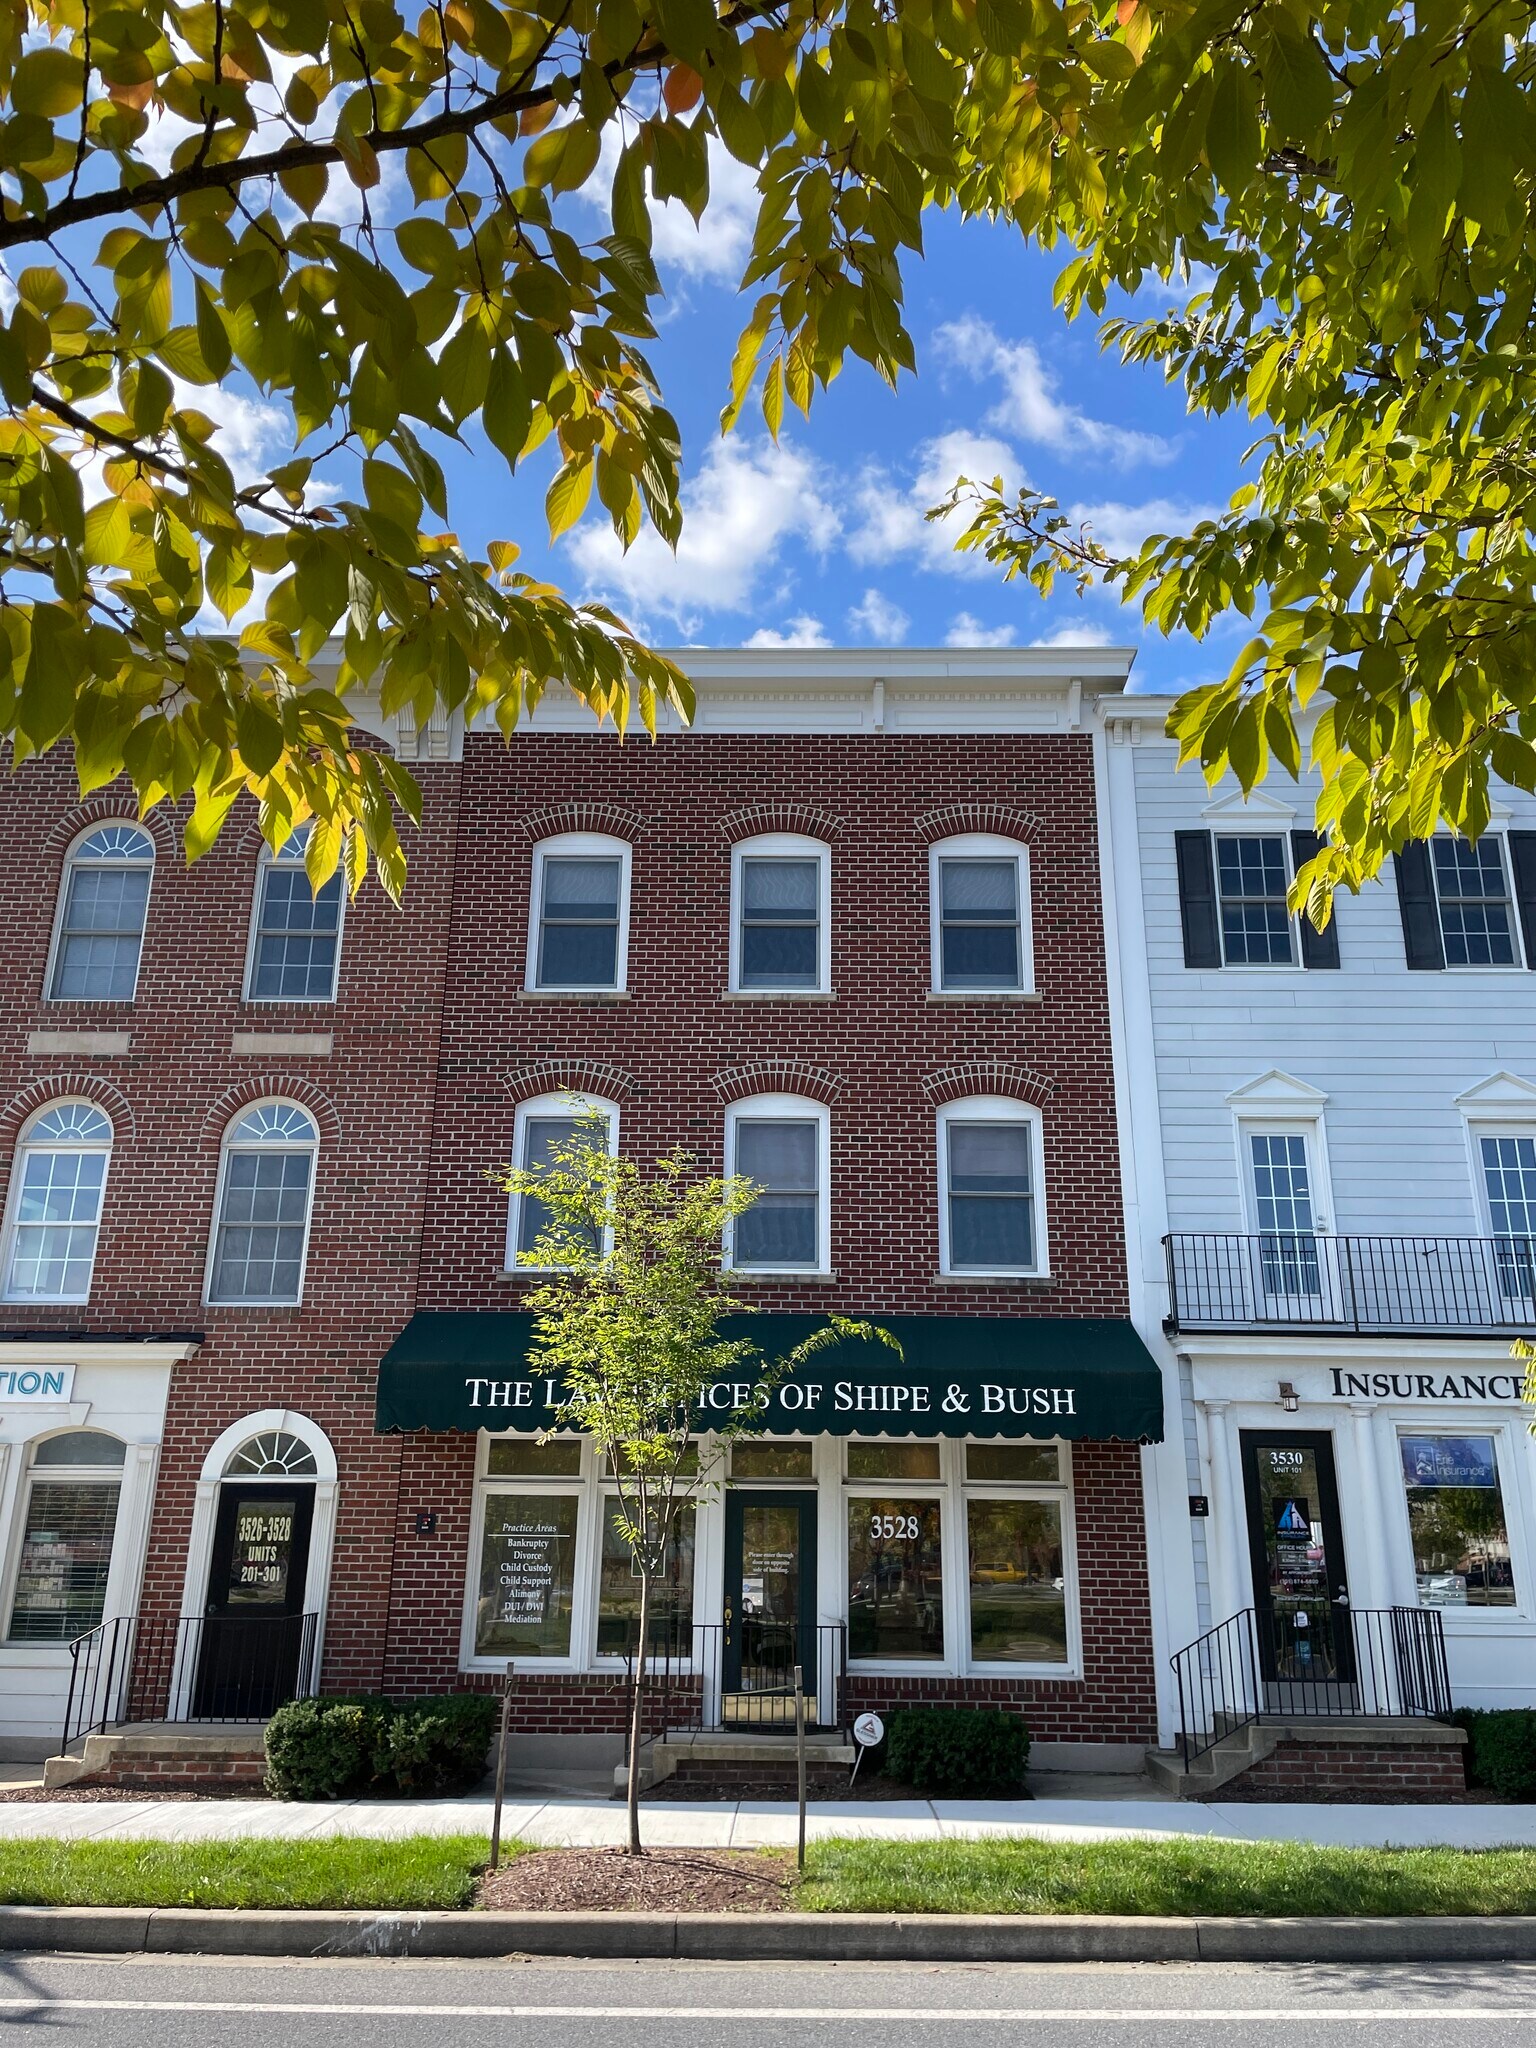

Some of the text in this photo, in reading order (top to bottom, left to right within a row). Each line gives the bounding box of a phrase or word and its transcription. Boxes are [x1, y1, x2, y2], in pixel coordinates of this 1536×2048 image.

[1329, 1368, 1527, 1399] INSURANCE
[465, 1378, 533, 1408] THE
[632, 1379, 770, 1410] ICES
[779, 1383, 823, 1411] OF
[834, 1381, 932, 1412] SHIPE
[941, 1383, 971, 1413] &
[980, 1384, 1077, 1414] BUSH
[1270, 1451, 1303, 1465] 3530
[1435, 1453, 1455, 1465] Erie
[1437, 1464, 1485, 1476] Insurance
[239, 1517, 292, 1541] 3526-3528
[502, 1523, 557, 1532] Practice Areas
[871, 1515, 919, 1539] 3528
[507, 1538, 549, 1549] Bankruptcy
[248, 1546, 277, 1561] UNITS
[513, 1550, 542, 1560] Divorce
[241, 1566, 281, 1582] 201-301
[500, 1563, 553, 1574] Child Custody
[500, 1576, 552, 1587] Child Support
[508, 1589, 541, 1600] Alimony
[504, 1615, 542, 1624] Mediation
